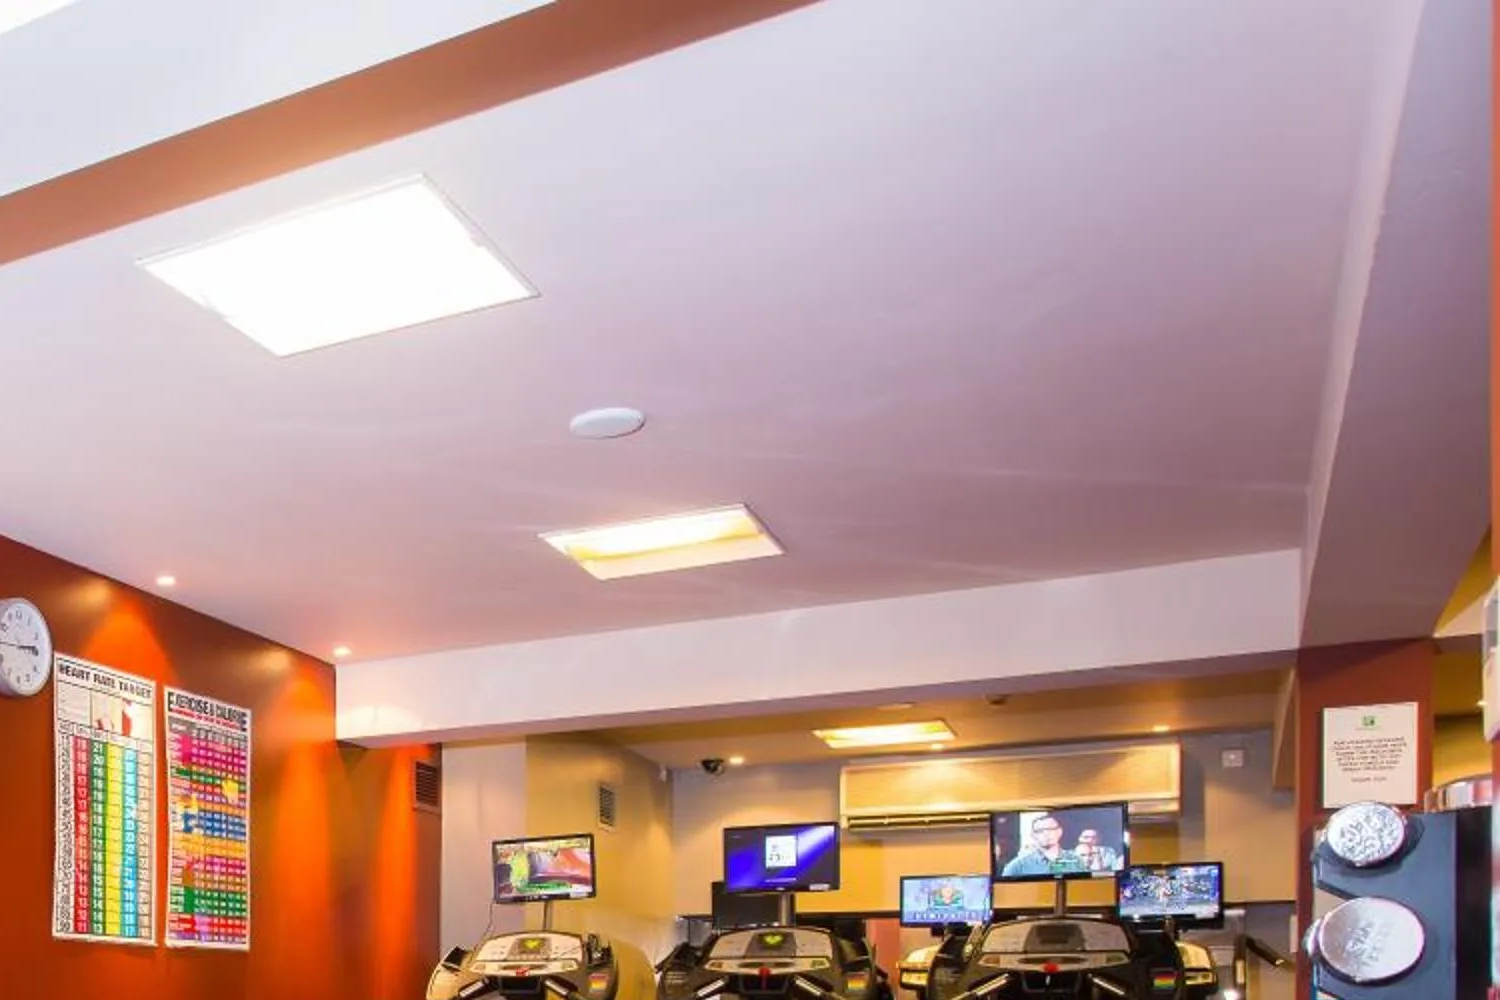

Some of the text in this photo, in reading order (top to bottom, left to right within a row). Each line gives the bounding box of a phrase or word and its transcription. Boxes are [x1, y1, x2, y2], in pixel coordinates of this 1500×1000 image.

[59, 664, 151, 699] HEART RATE TARGET
